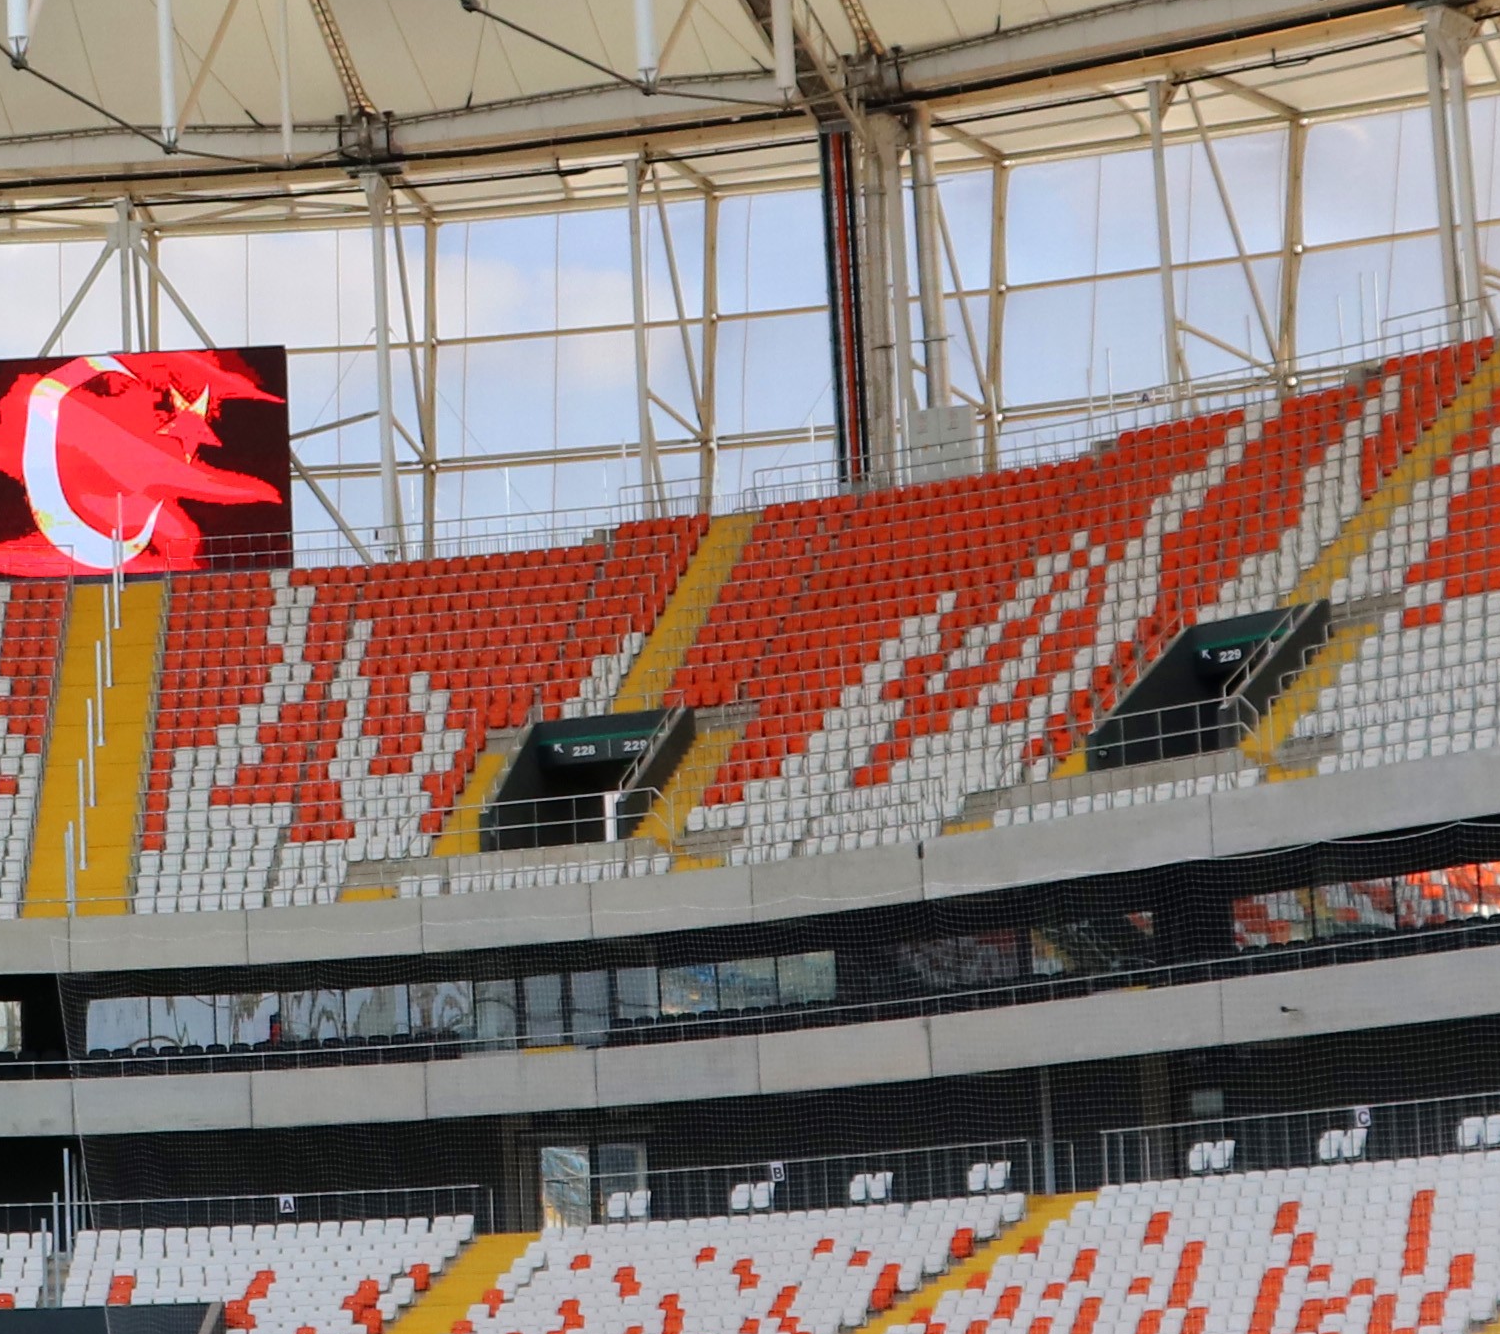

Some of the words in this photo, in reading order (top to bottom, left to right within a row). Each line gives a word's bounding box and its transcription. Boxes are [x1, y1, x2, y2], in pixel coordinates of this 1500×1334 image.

[1219, 648, 1242, 663] 229
[572, 744, 596, 757] 228
[1358, 1111, 1369, 1125] C
[772, 1167, 783, 1180] B
[282, 1199, 293, 1211] A
